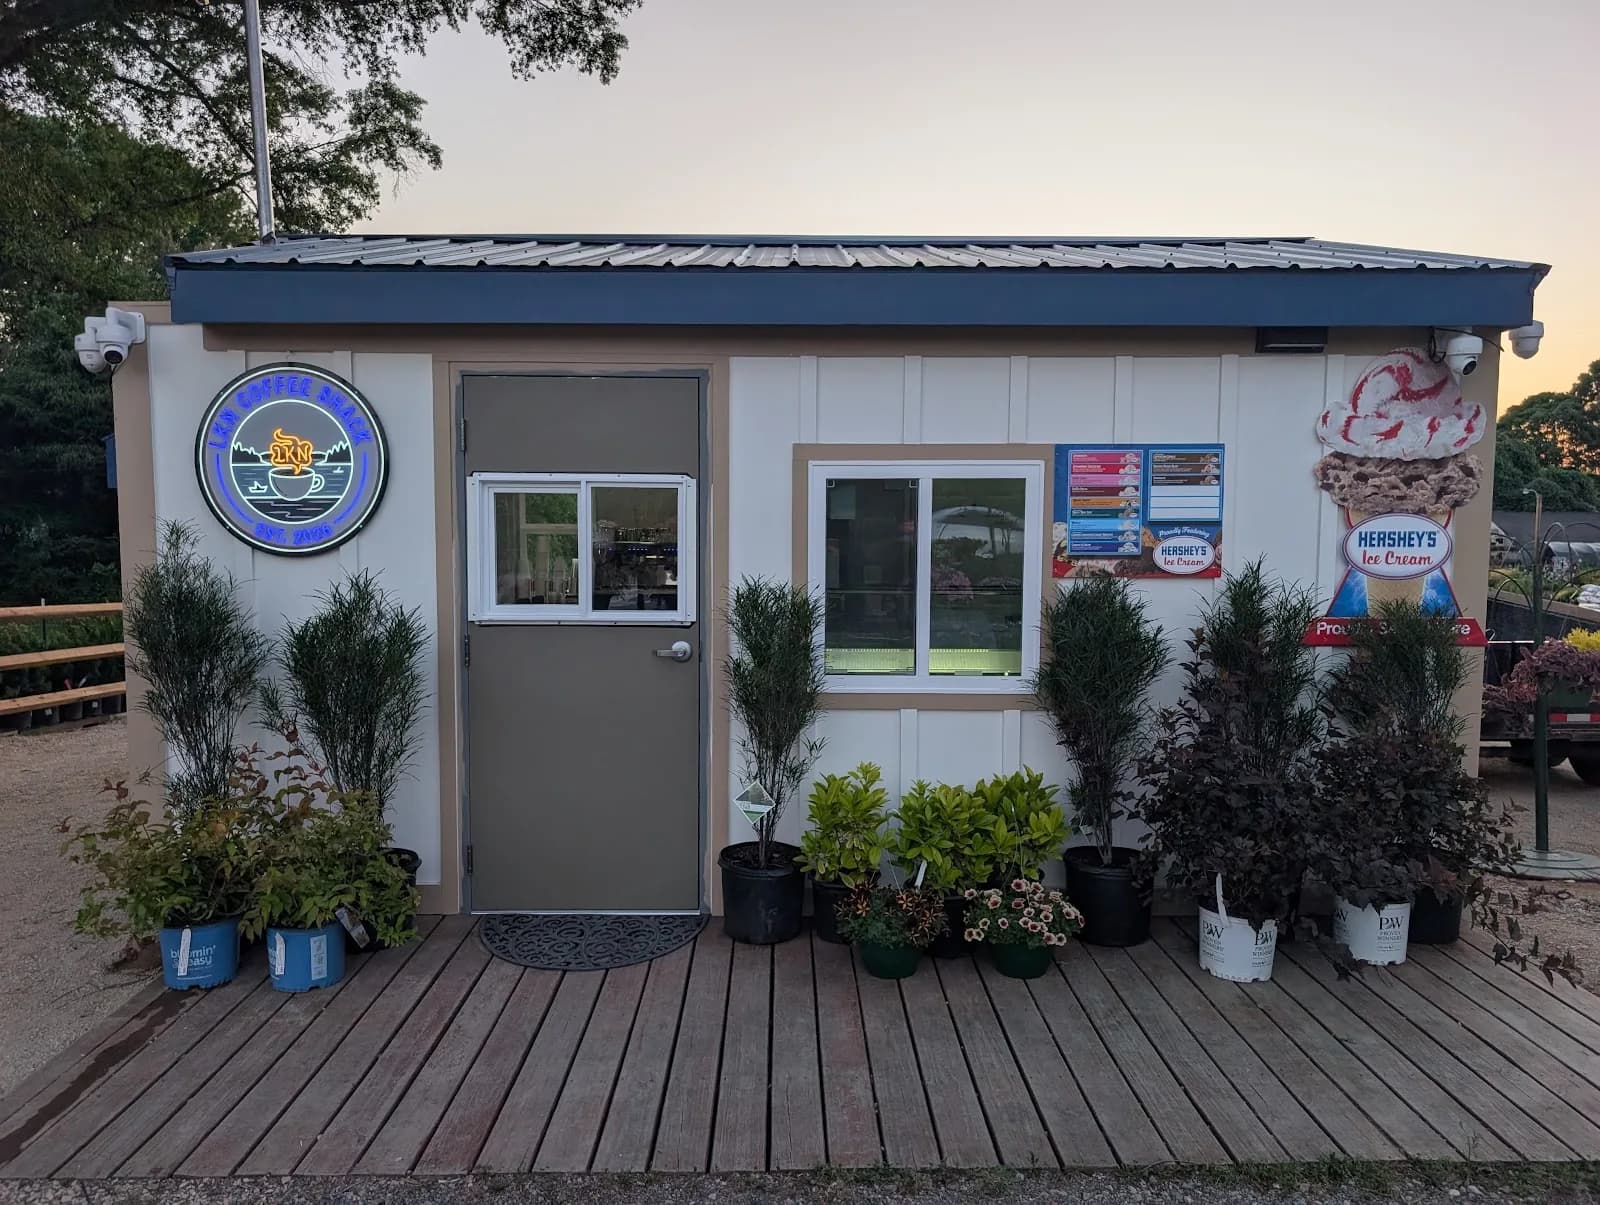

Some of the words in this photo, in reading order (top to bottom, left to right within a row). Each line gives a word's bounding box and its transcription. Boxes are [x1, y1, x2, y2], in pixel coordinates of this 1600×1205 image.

[208, 407, 238, 449] LKN
[237, 375, 313, 410] COFFEE
[317, 384, 372, 446] SHACK
[1358, 530, 1437, 548] HERSHEY'S
[1161, 545, 1207, 556] HERSHEY'S
[1362, 549, 1382, 566] Ice
[1385, 550, 1434, 566] Cream
[1163, 556, 1175, 566] Ice
[1177, 556, 1206, 566] Cream
